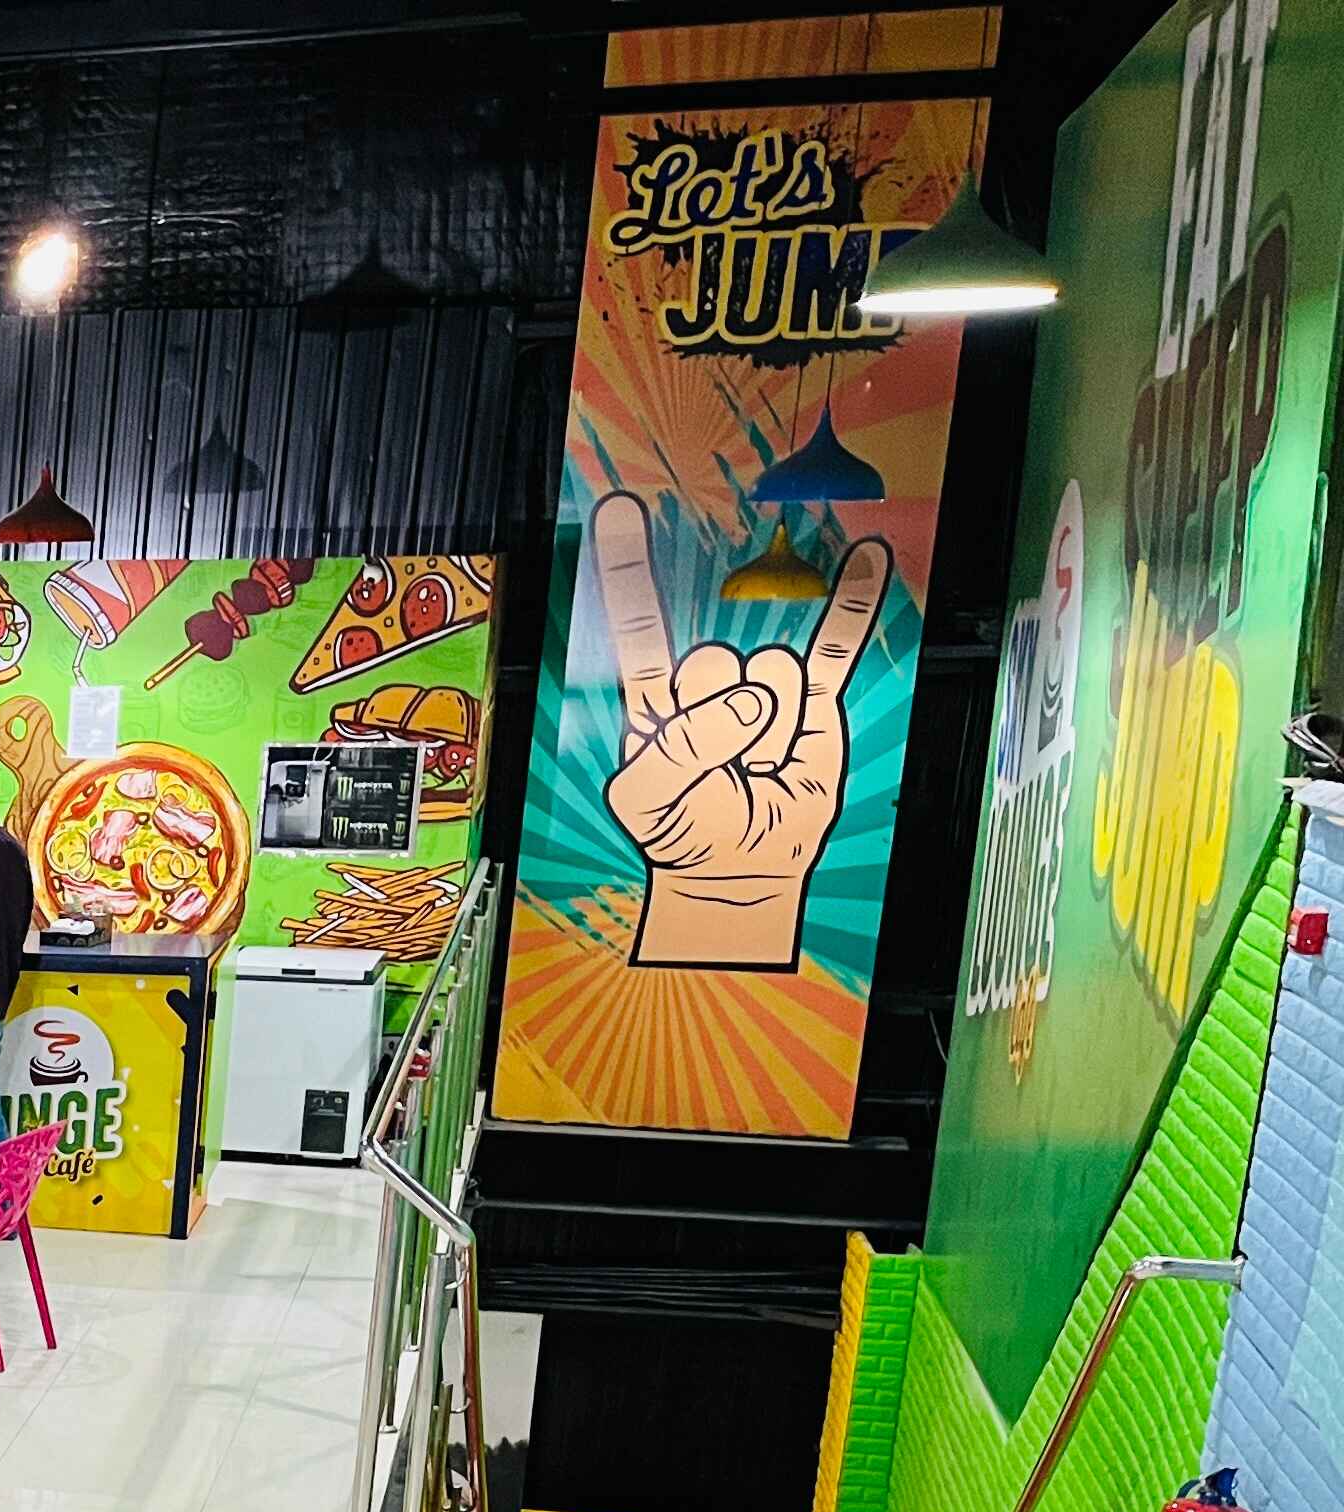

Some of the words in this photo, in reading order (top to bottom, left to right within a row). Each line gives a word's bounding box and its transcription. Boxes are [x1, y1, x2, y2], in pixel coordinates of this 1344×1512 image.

[606, 128, 835, 253] Let's
[1092, 559, 1240, 1021] JUMP
[969, 750, 1072, 998] LOUNGE
[0, 1087, 121, 1155] NGE
[43, 1149, 95, 1182] Café
